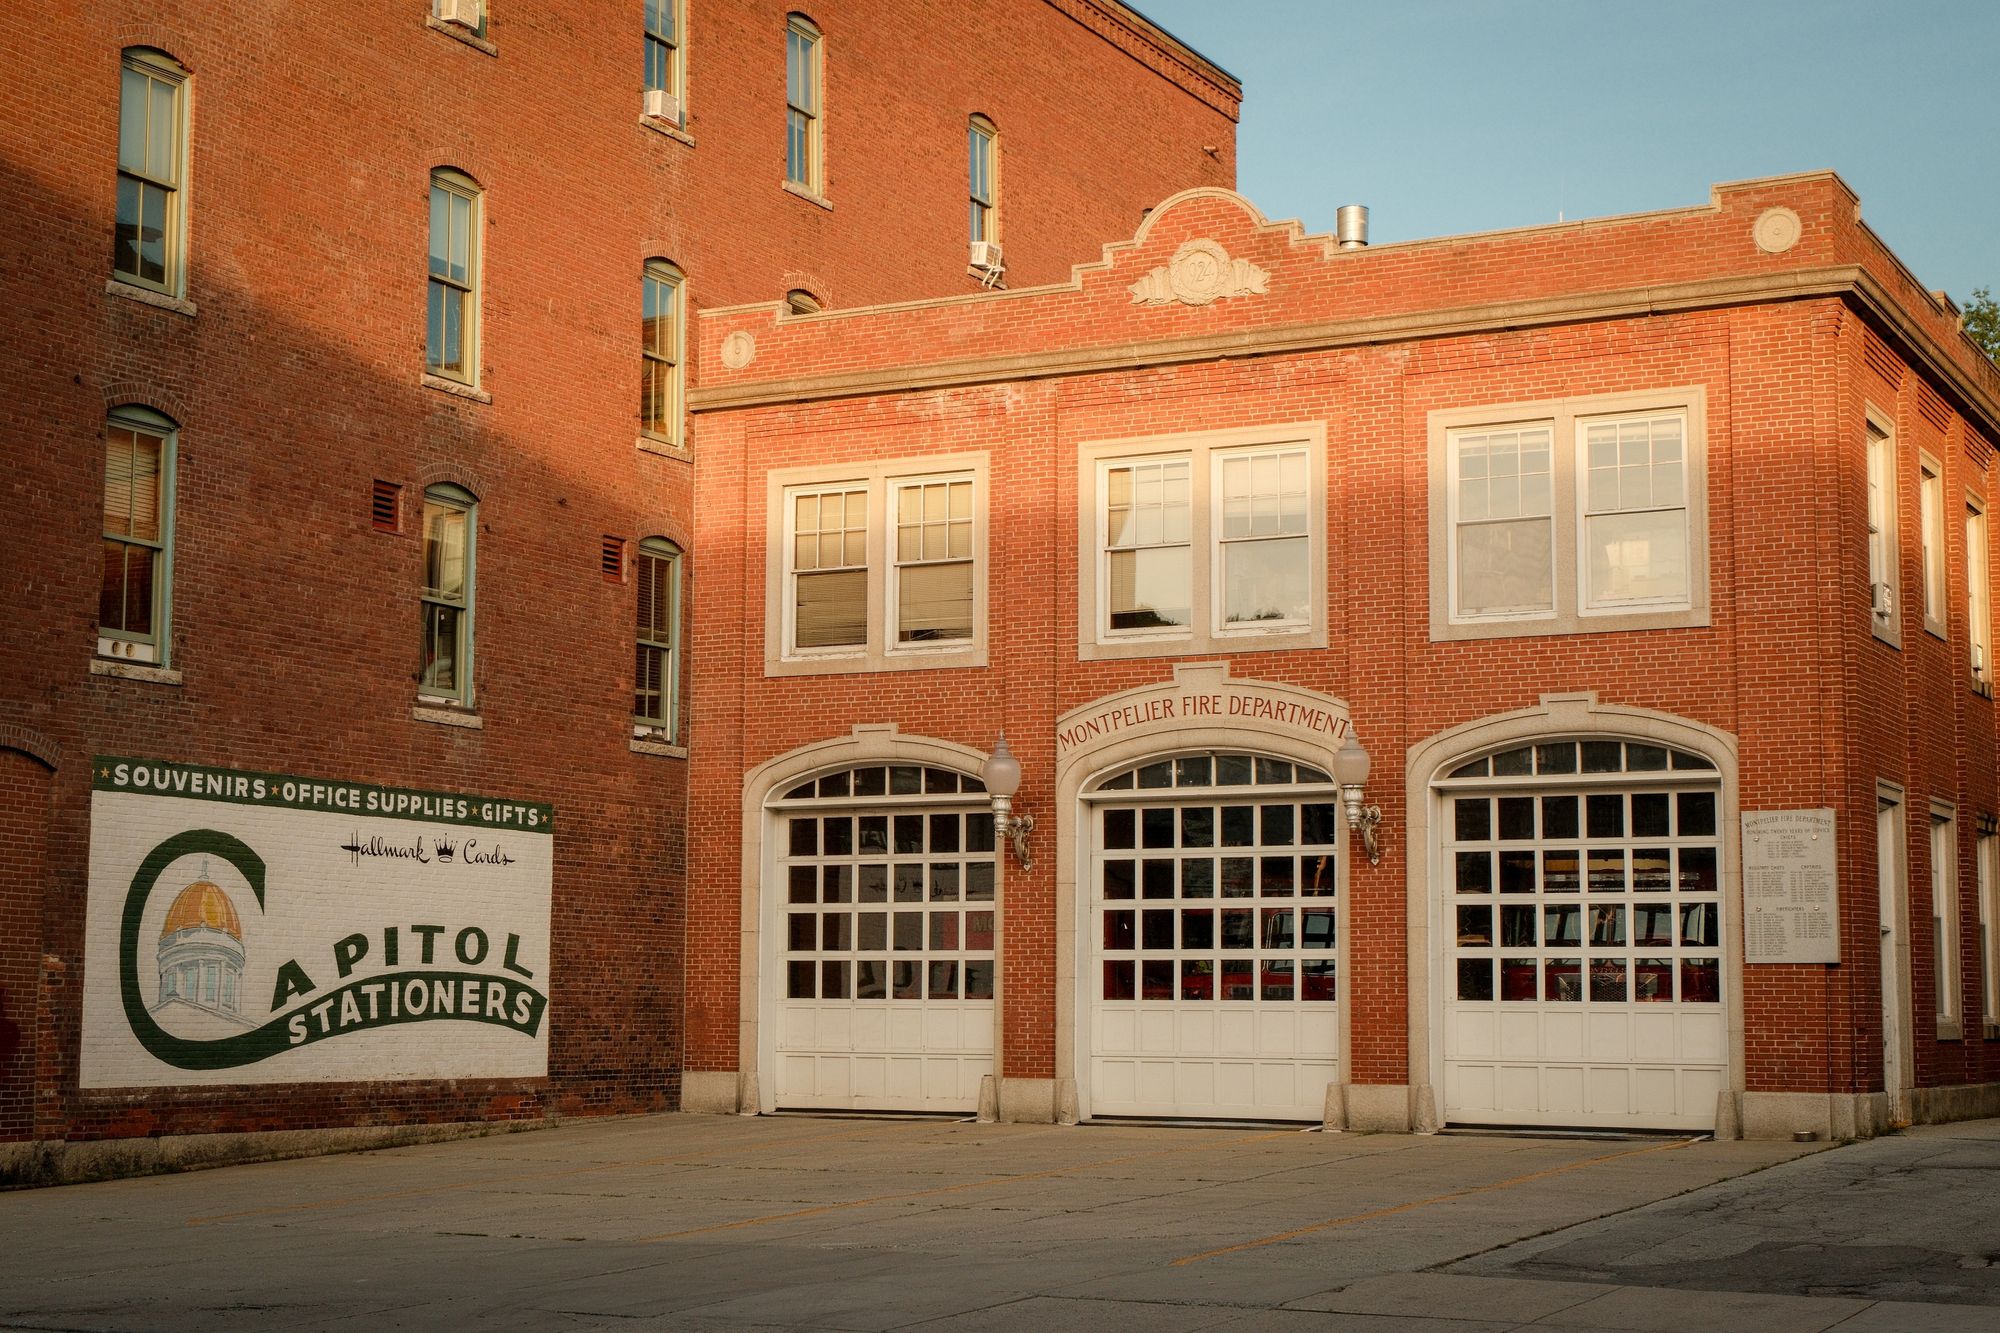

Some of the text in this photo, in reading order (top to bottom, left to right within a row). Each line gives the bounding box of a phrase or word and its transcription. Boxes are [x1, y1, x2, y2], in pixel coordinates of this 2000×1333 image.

[1058, 695, 1350, 751] MONTPELIER FIRE DEPARTMENT
[114, 763, 539, 826] SOUVENIRS OFFICE SUPPLIES GIFTS
[340, 829, 515, 867] Hallmark Cards
[120, 828, 535, 1070] CAPITOL
[288, 978, 533, 1044] STATIONERS
